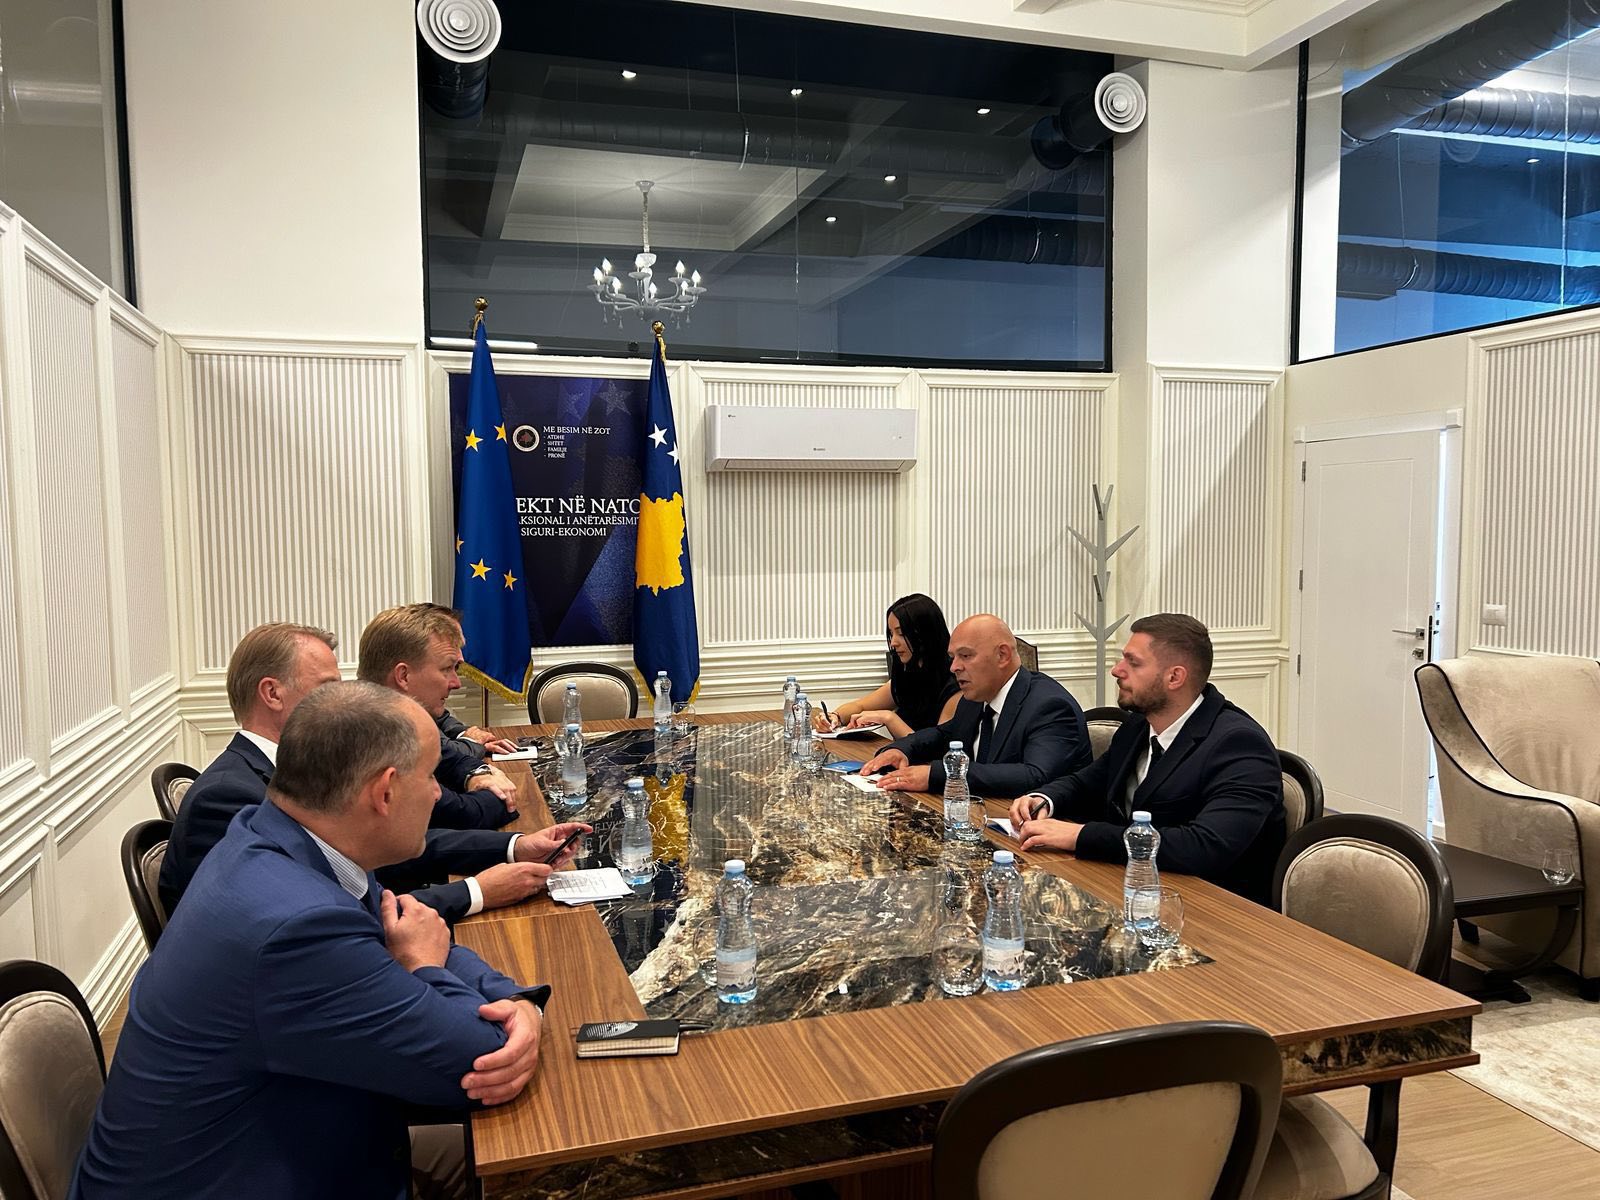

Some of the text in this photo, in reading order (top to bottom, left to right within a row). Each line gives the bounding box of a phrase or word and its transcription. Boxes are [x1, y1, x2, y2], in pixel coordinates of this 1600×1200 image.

[557, 426, 580, 434] BESIM
[582, 426, 593, 434] NË
[594, 427, 611, 435] ZOT
[516, 498, 554, 513] EKT
[559, 495, 585, 513] NË
[519, 515, 565, 525] KSIONAL
[567, 516, 571, 525] I
[520, 527, 607, 537] SIGURI-EKONOMI
